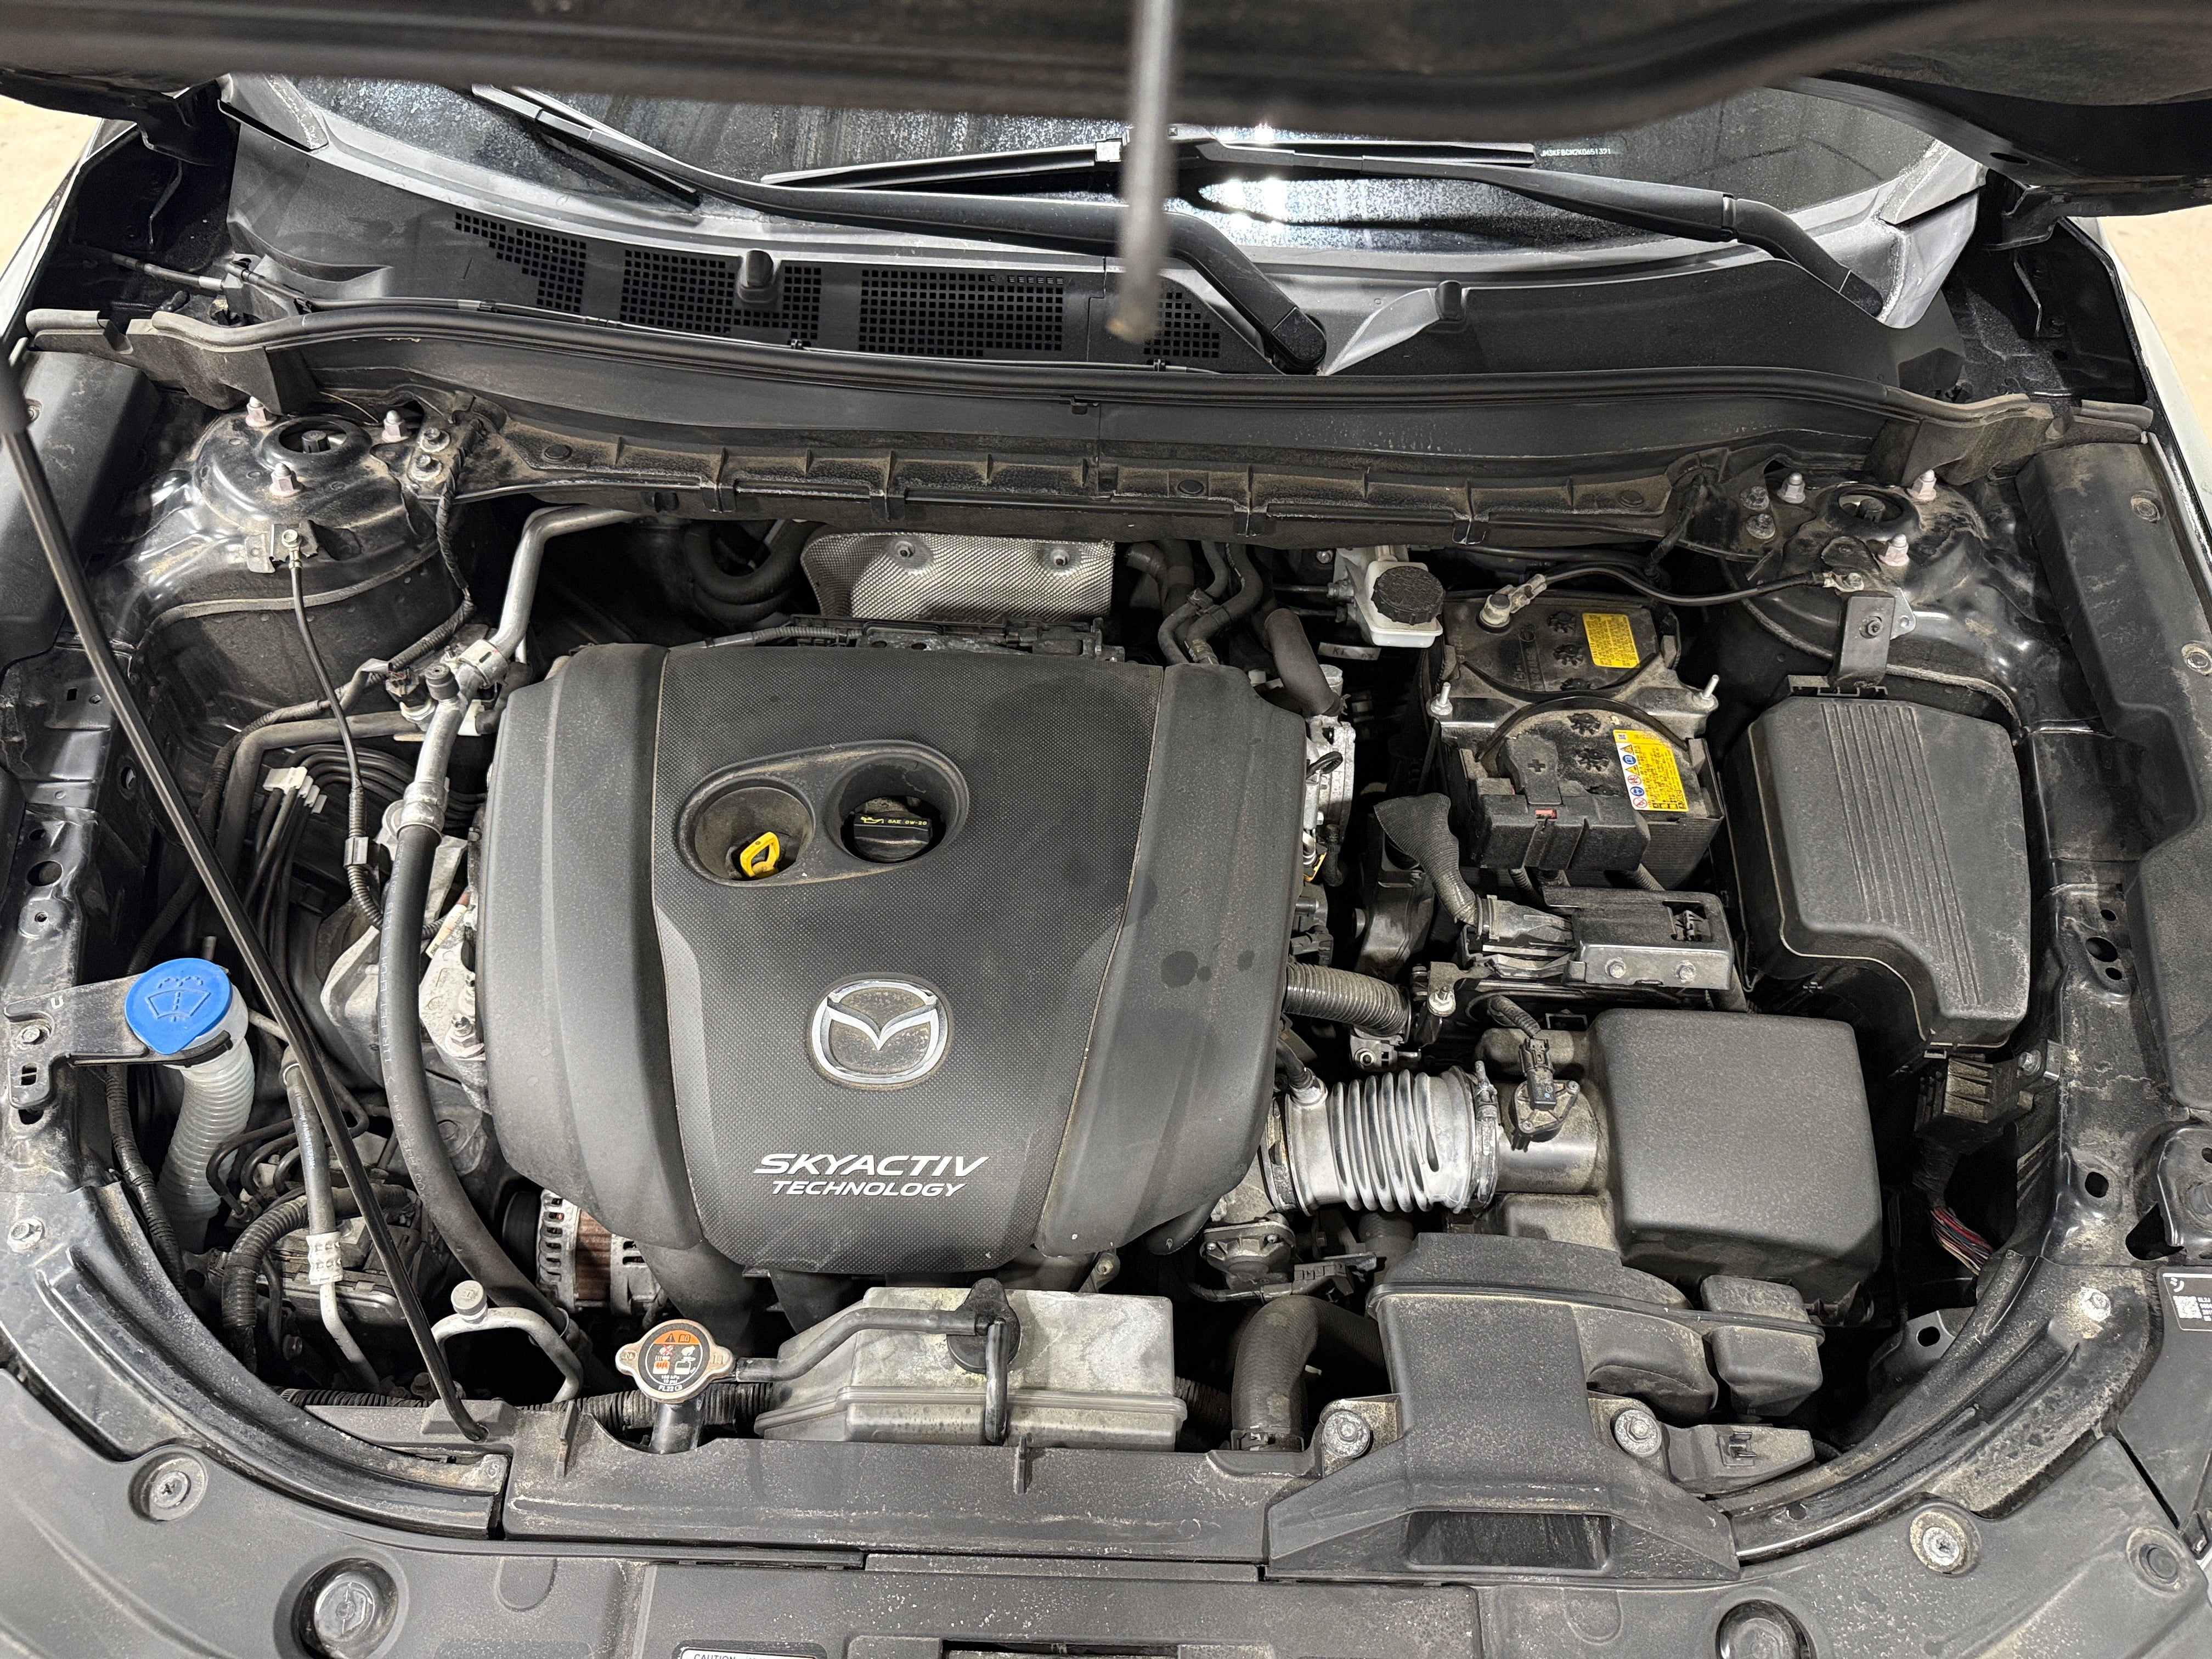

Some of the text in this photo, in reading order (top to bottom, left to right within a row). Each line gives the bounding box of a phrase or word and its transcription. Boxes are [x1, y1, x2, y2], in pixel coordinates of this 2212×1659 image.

[380, 956, 388, 992] EPDM
[753, 1153, 990, 1177] SKYACTIV
[772, 1180, 968, 1198] TECHNOLOGY
